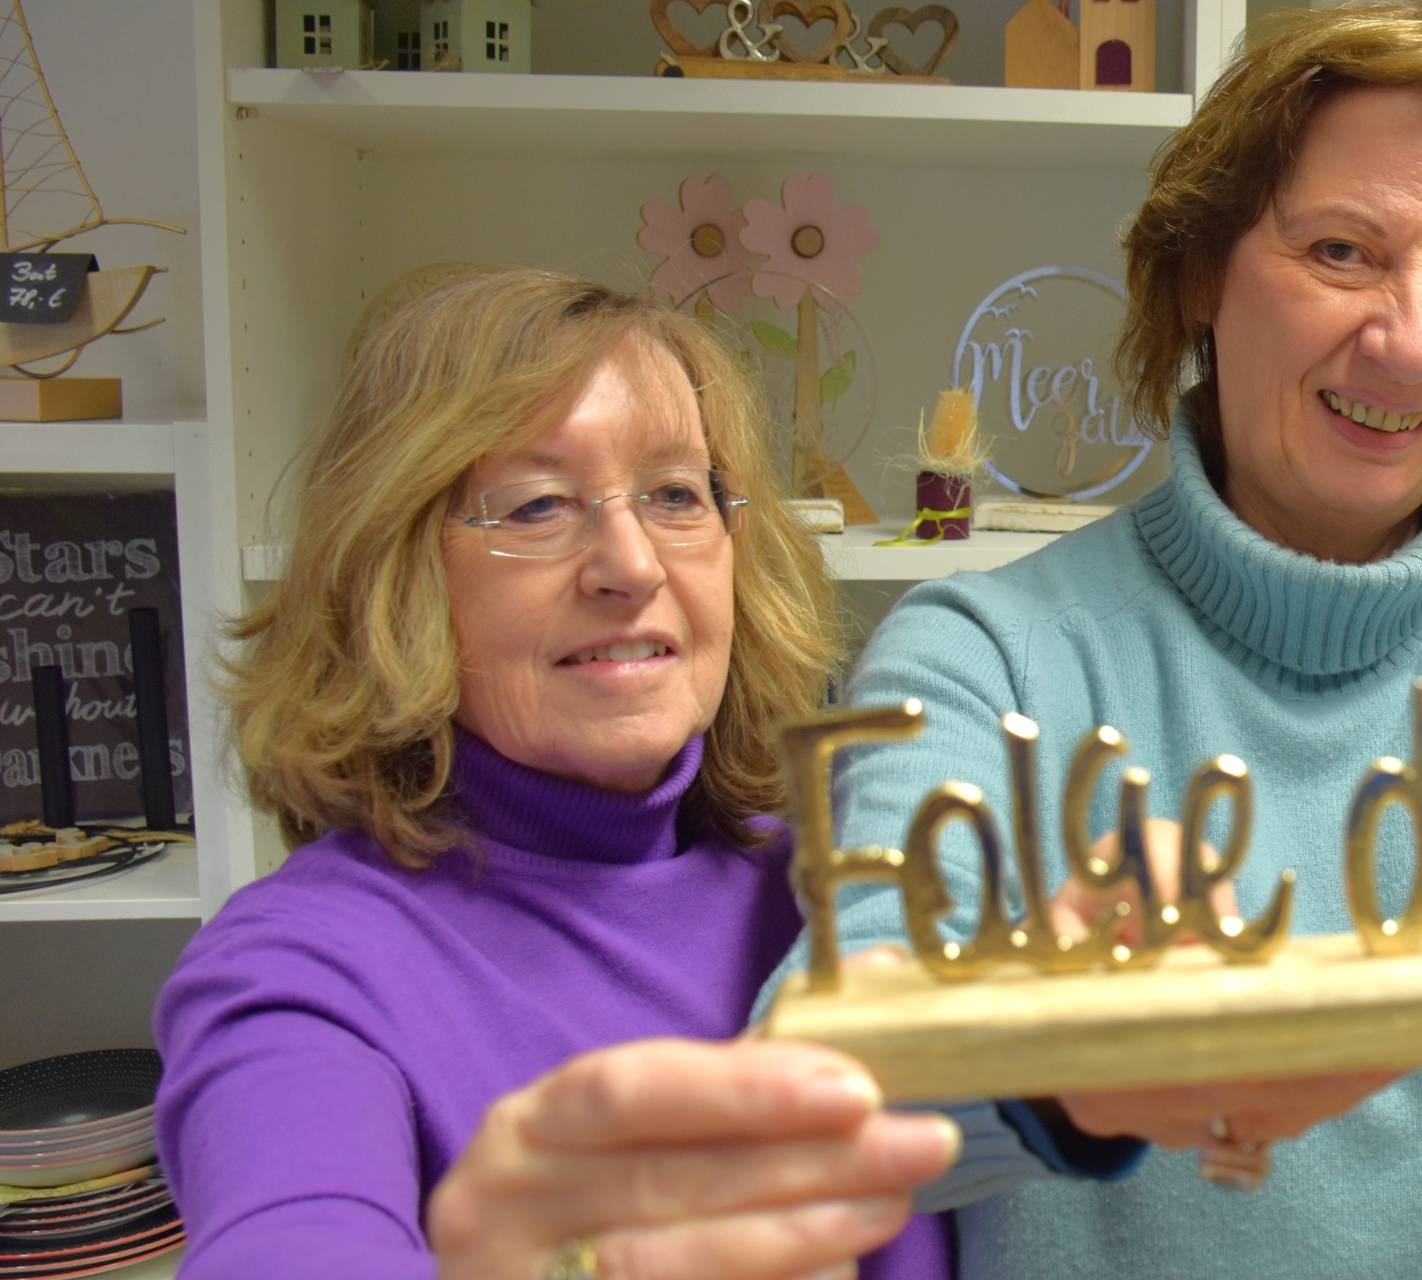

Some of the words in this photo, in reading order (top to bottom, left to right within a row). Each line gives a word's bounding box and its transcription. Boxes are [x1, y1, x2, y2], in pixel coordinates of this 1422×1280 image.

[967, 338, 1104, 432] Meer
[0, 682, 138, 726] whout
[778, 698, 1296, 995] Folge
